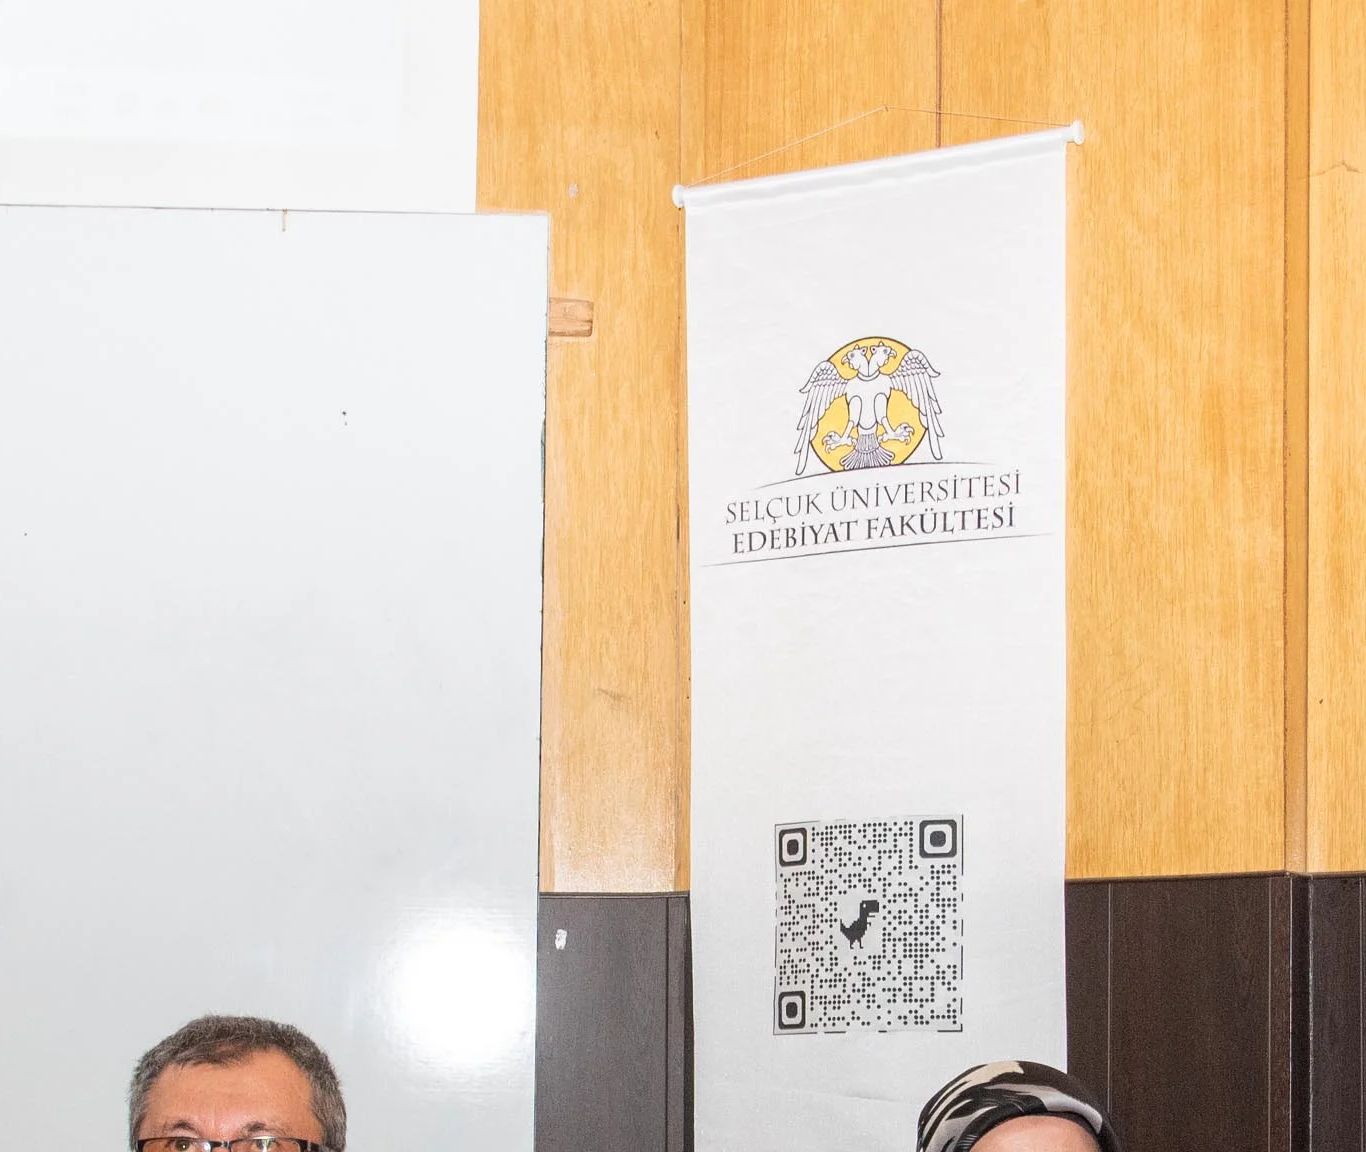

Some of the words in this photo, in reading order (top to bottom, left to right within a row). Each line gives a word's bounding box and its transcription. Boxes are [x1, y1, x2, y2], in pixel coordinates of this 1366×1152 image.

[725, 491, 825, 526] SELÇUK
[830, 469, 1023, 511] ÜNİVERSİTESİ
[732, 520, 858, 554] EDEBİYAT
[866, 501, 1017, 540] FAKÜLTESİ
